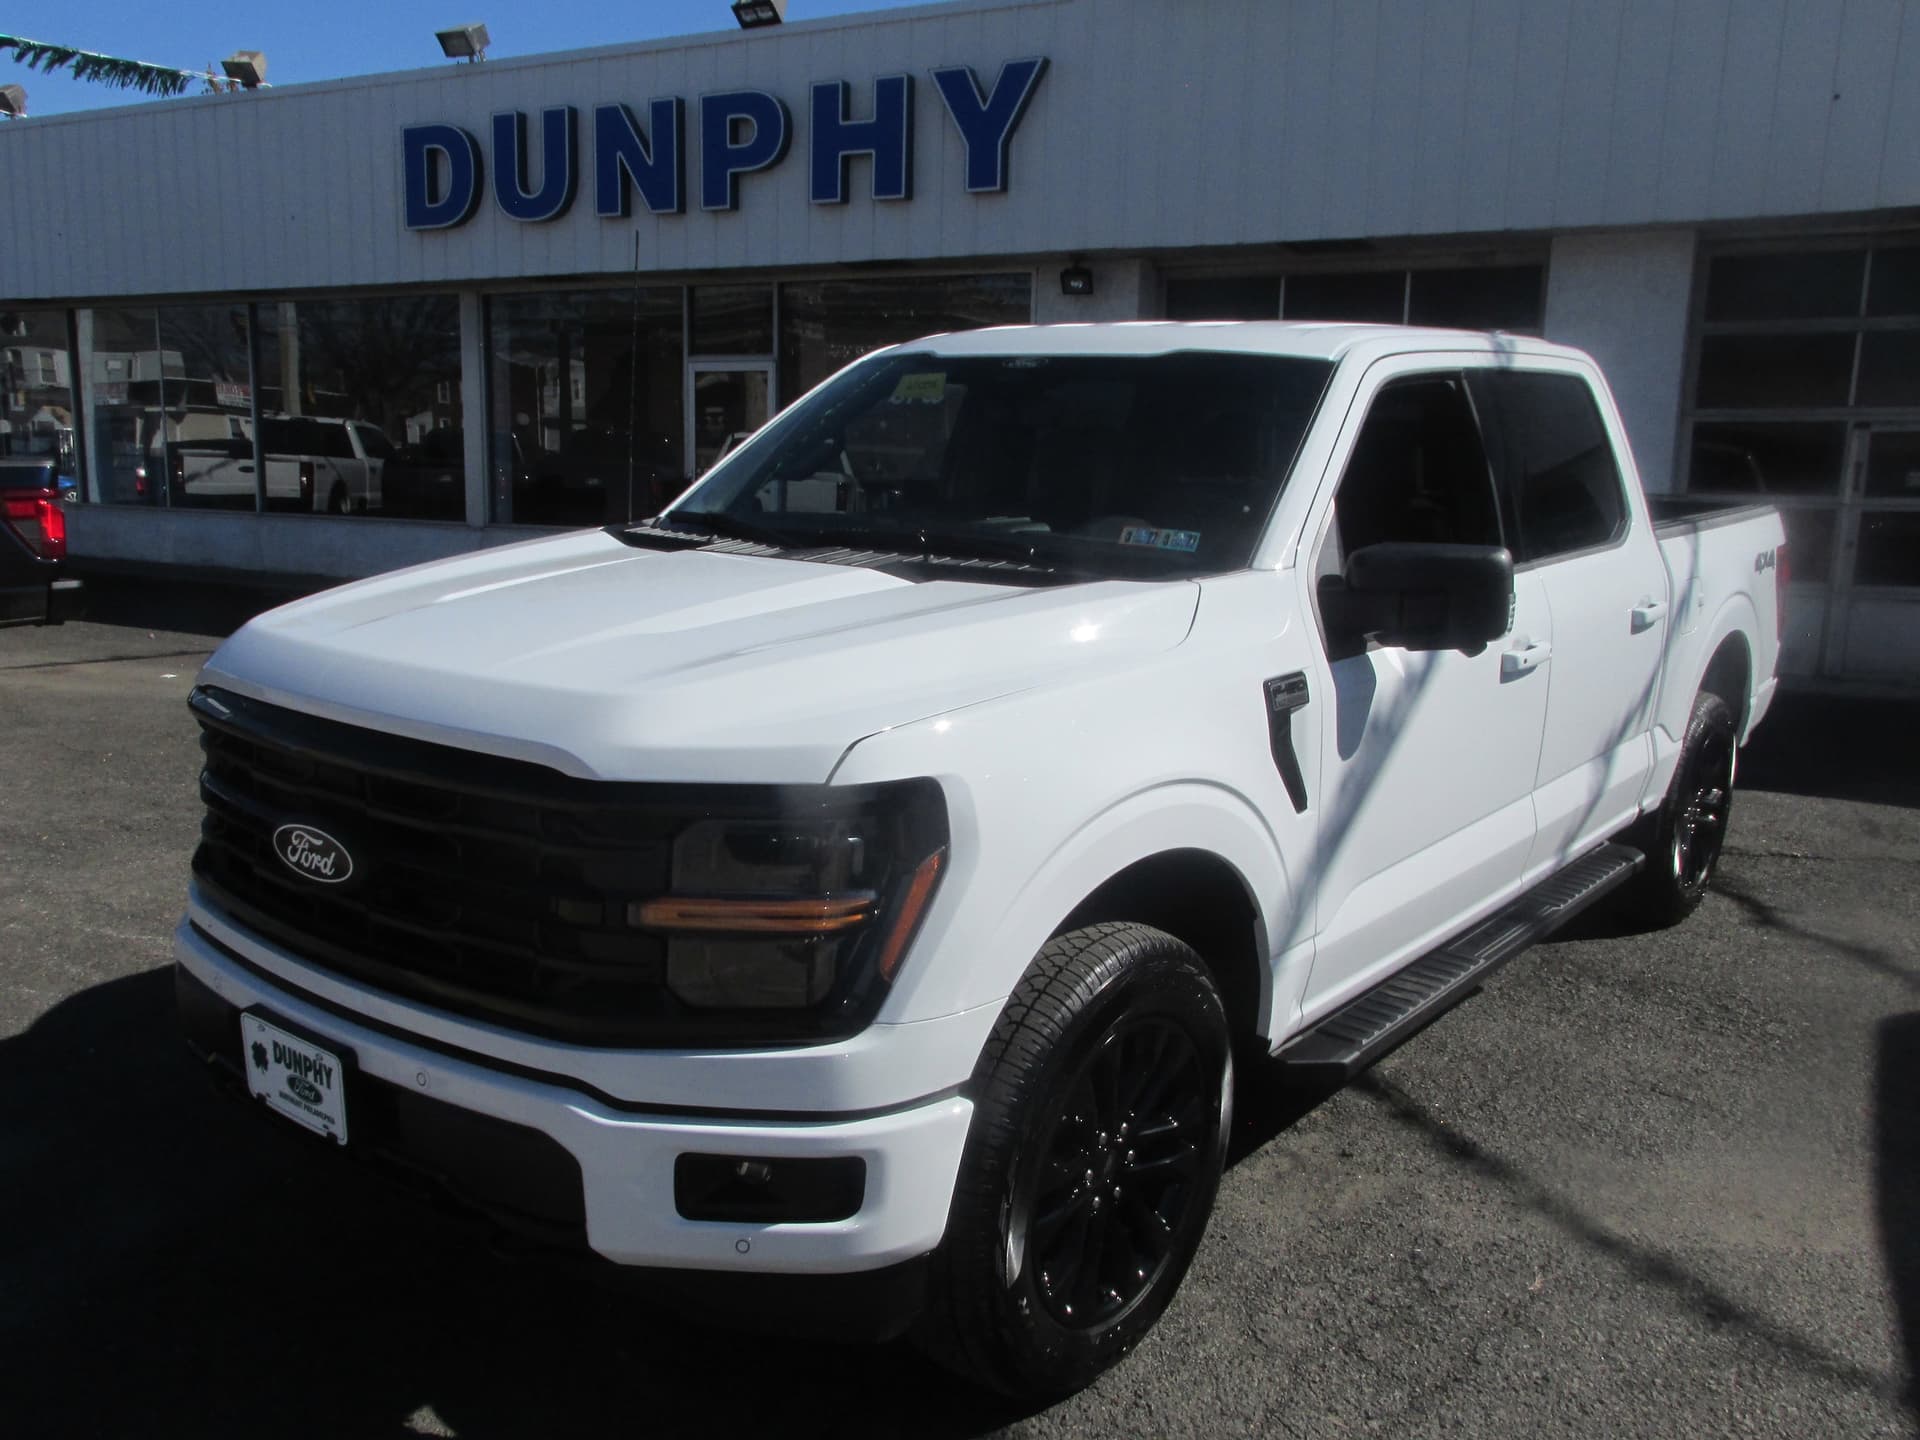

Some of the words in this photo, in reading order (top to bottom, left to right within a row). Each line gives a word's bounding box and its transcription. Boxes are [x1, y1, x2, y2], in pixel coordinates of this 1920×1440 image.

[403, 56, 1049, 231] DUNPHY
[287, 830, 336, 876] Ford
[272, 1040, 333, 1091] DUNPHY
